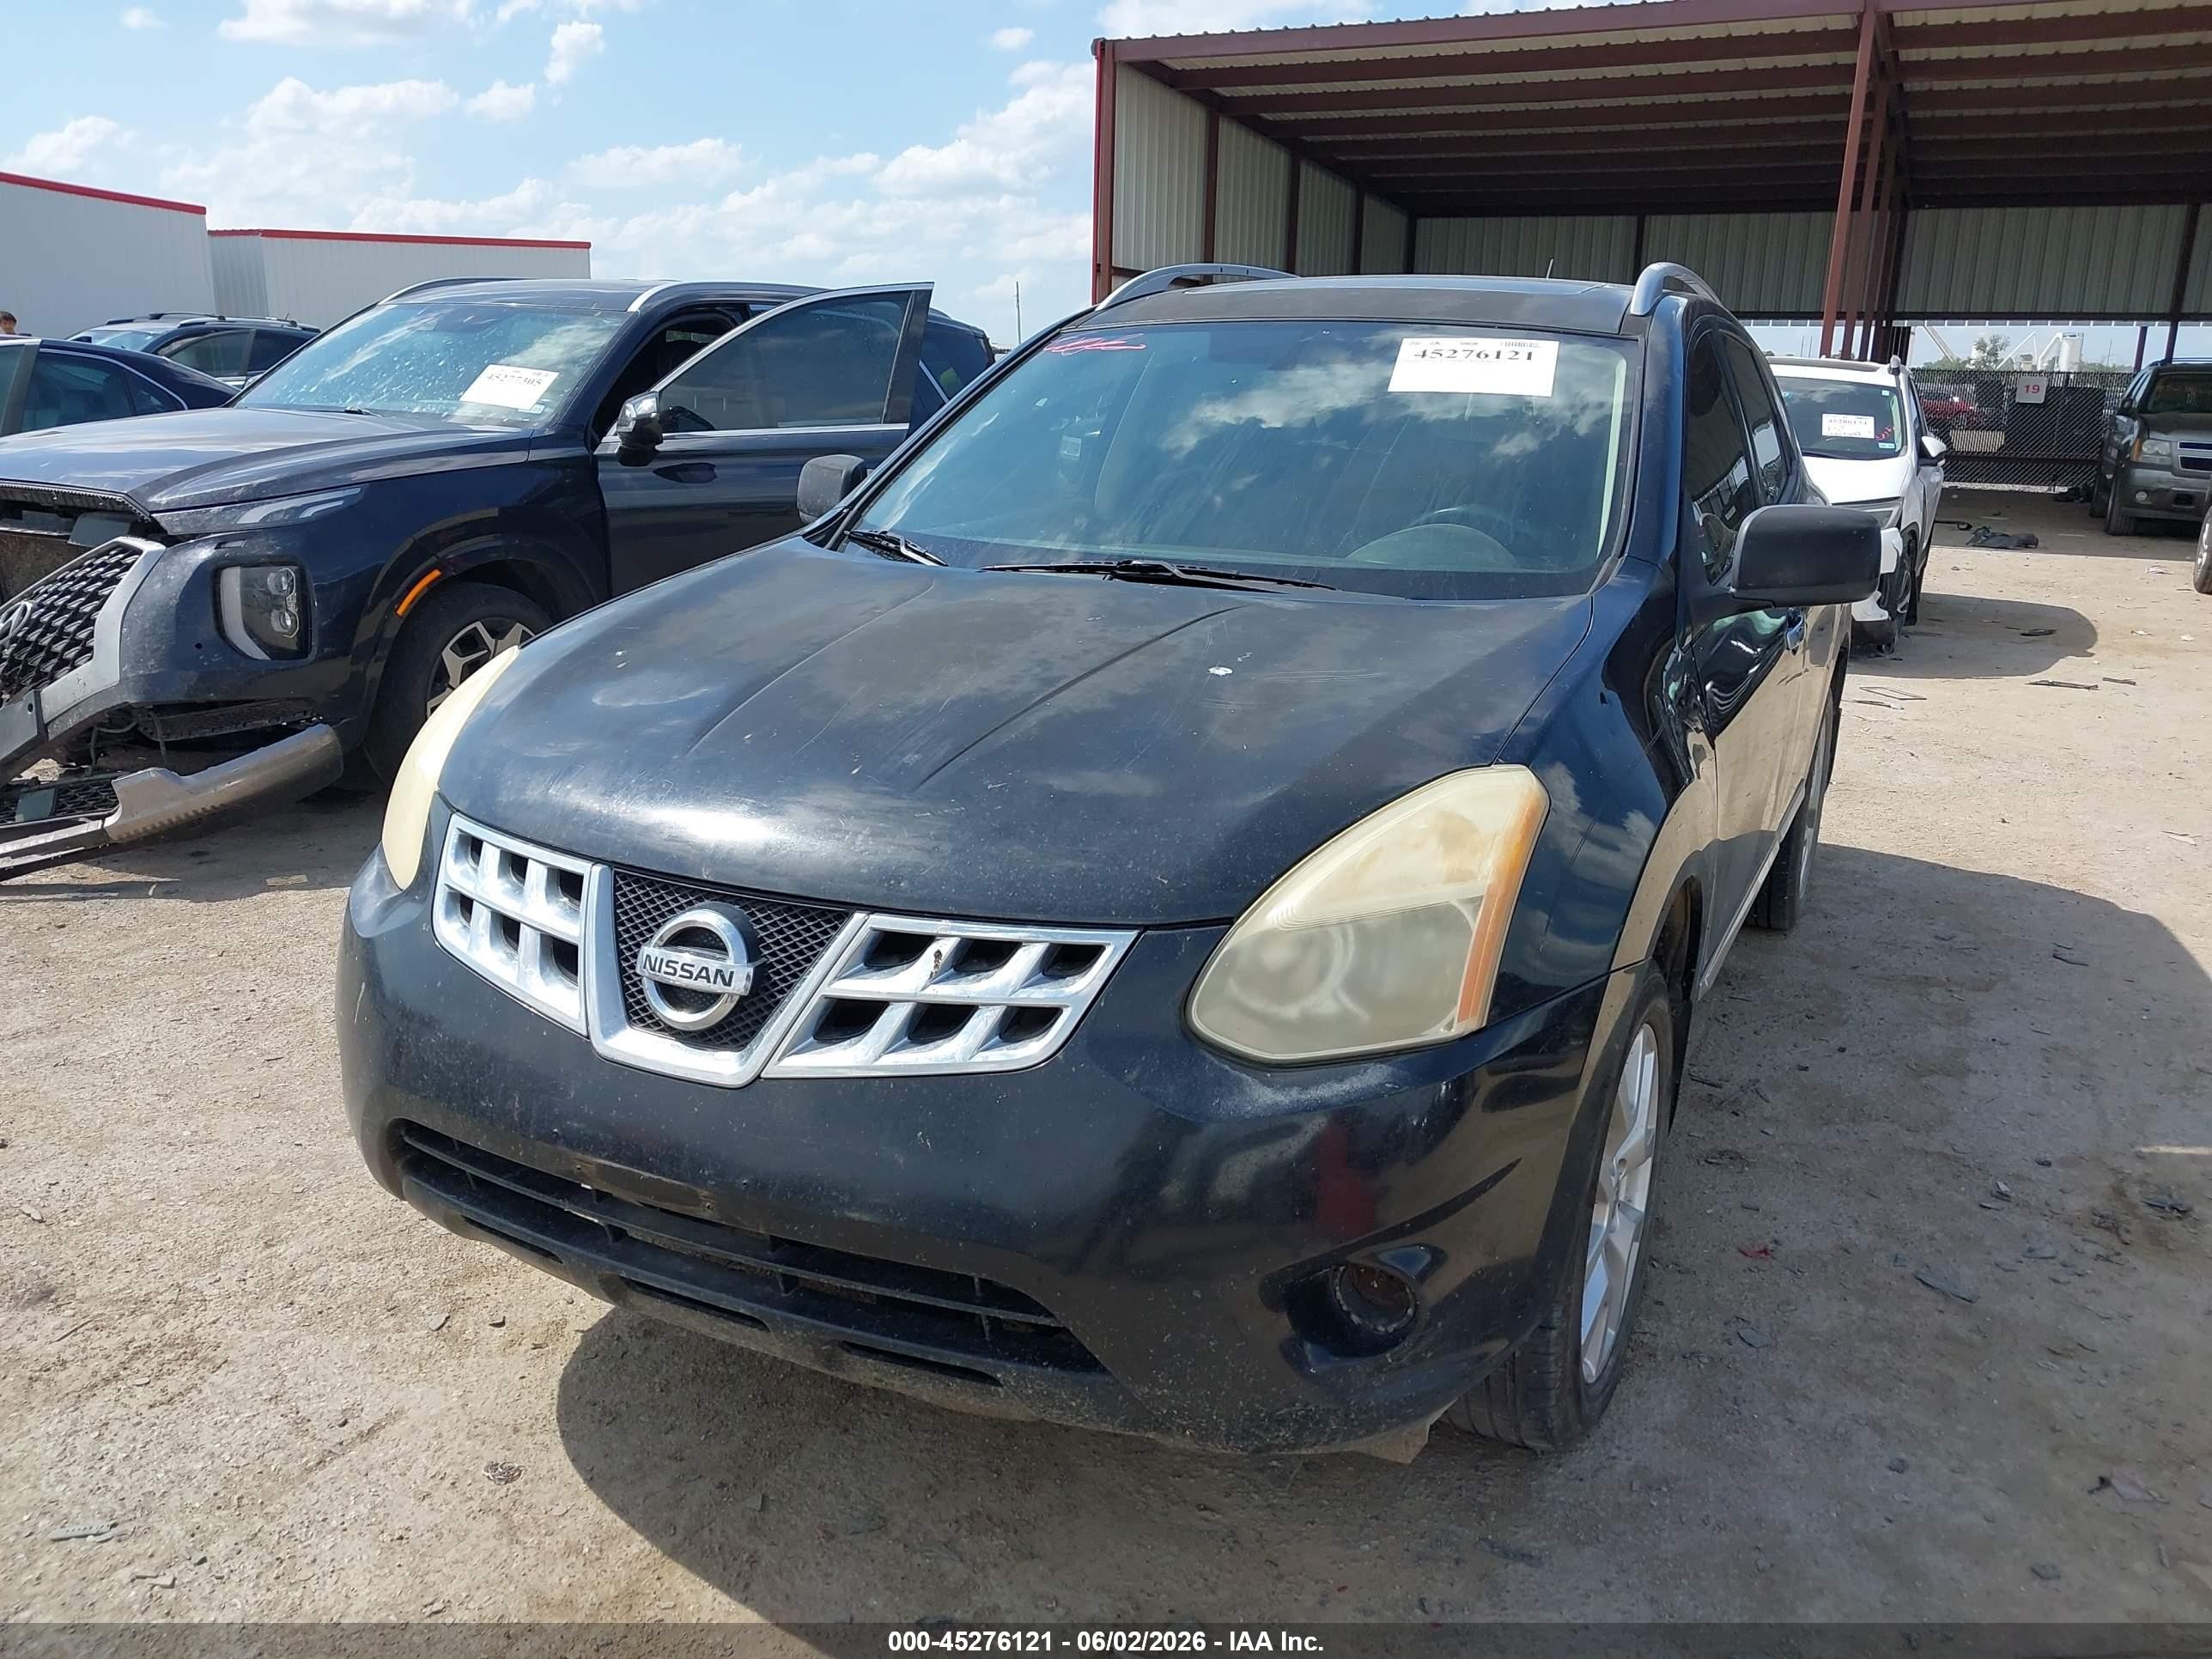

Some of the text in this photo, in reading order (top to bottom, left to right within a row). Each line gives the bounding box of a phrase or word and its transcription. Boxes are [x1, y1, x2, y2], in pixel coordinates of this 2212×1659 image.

[1414, 348, 1534, 361] 45276121
[2023, 384, 2040, 394] 19
[643, 953, 735, 988] NISSAN
